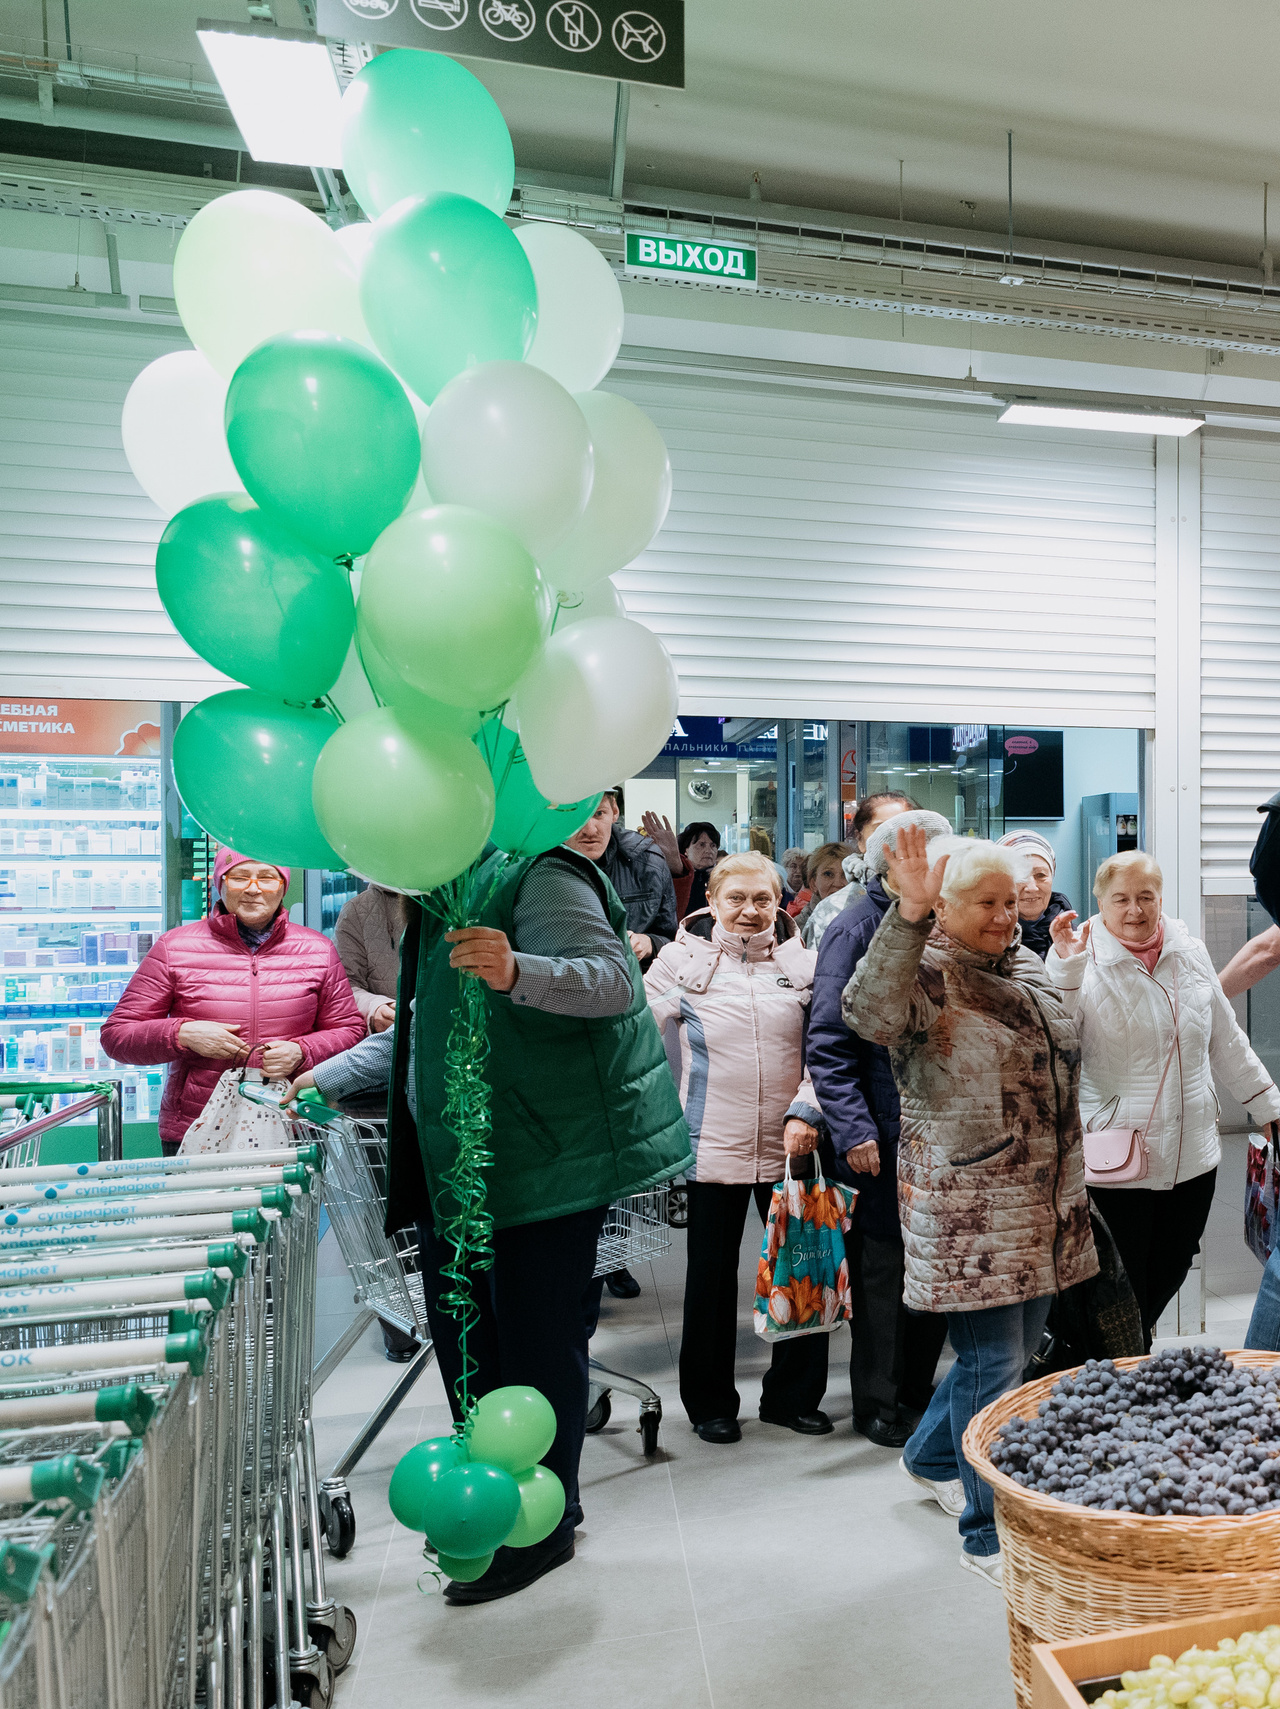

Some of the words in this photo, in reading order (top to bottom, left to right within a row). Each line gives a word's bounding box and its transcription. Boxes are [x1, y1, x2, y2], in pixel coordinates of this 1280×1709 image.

[639, 239, 745, 276] ВЫХОД
[0, 721, 75, 734] МЕТИКА
[105, 1158, 191, 1173] супермаркет
[75, 1181, 167, 1196] супермаркет
[38, 1206, 137, 1222] супермаркет
